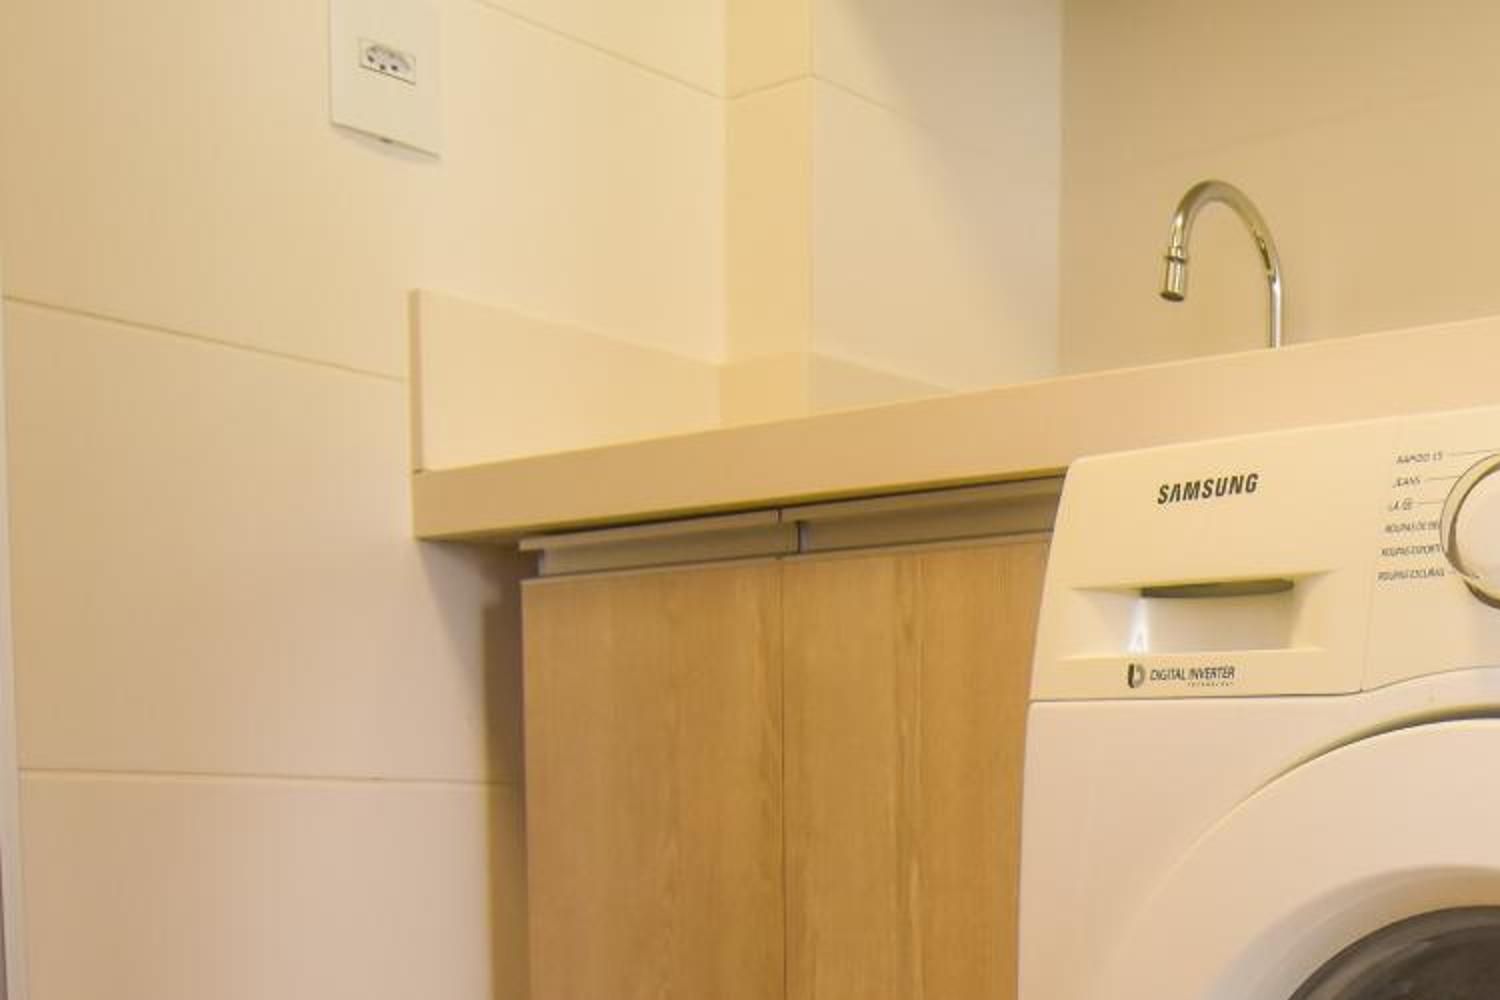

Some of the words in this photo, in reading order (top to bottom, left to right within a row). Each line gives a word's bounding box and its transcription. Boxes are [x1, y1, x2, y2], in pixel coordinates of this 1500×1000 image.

[1157, 472, 1259, 505] SAMSUNG
[1150, 668, 1186, 681] DIGITAL
[1187, 666, 1236, 680] INVERTER
